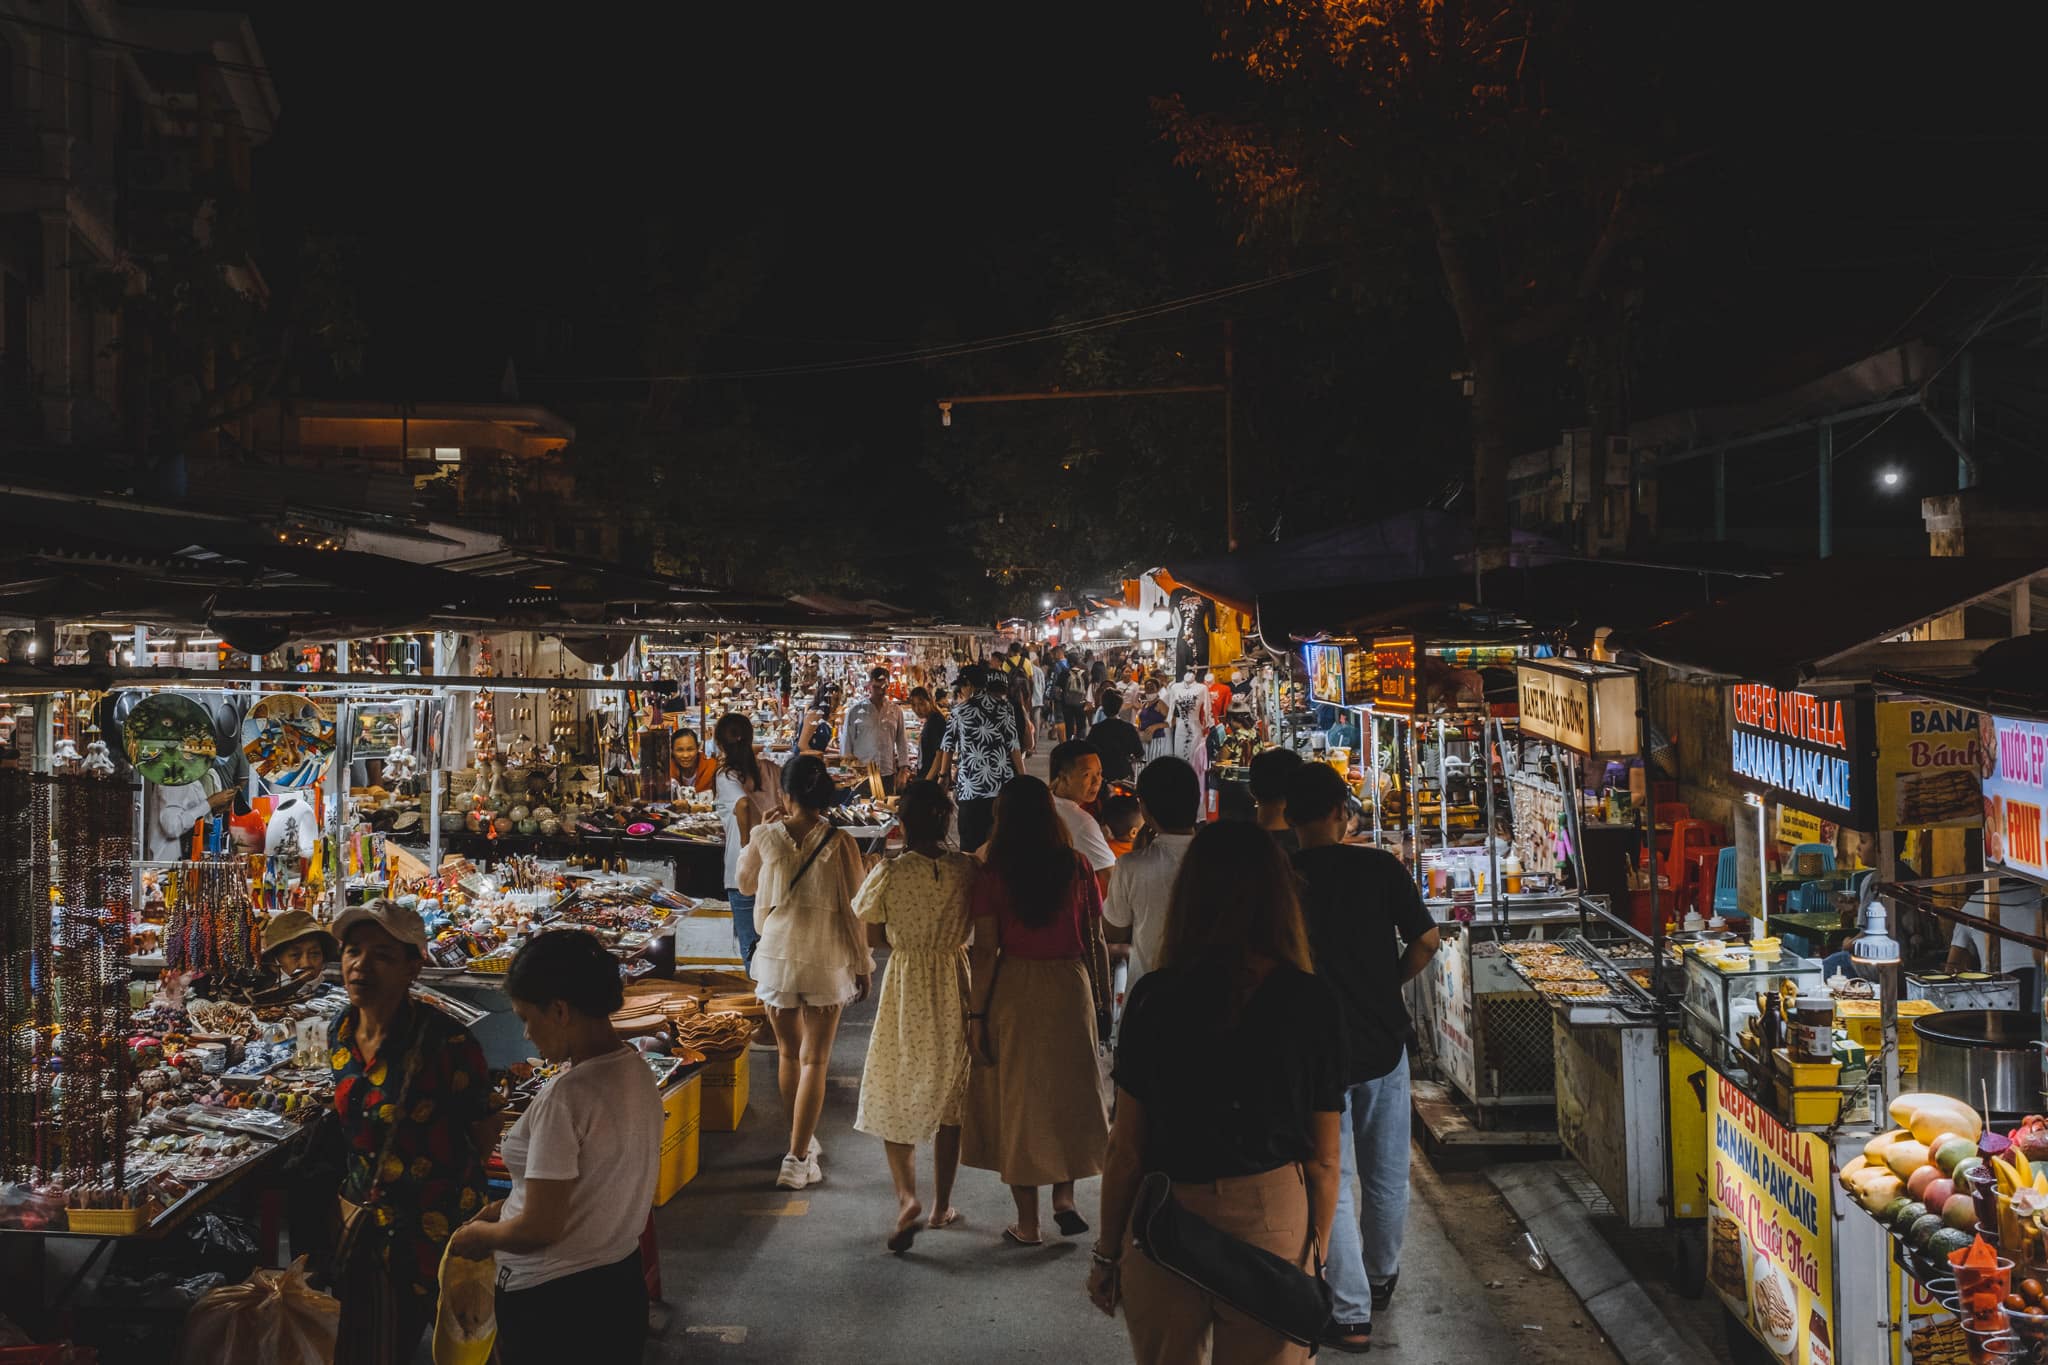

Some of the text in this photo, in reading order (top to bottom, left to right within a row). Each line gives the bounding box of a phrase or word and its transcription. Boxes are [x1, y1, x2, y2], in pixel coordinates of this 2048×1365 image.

[1734, 684, 1846, 750] CREPES NUTELLA
[1909, 741, 1983, 767] Bánh
[1733, 730, 1851, 811] BANANA PANCAKE
[2007, 800, 2042, 866] FRUIT
[1718, 1075, 1756, 1133] CREPES
[1758, 1109, 1813, 1183] NUTELLA
[1716, 1113, 1818, 1236] BANANA PANCAKE
[1715, 1161, 1746, 1225] Bánh
[1786, 1230, 1821, 1296] Thái
